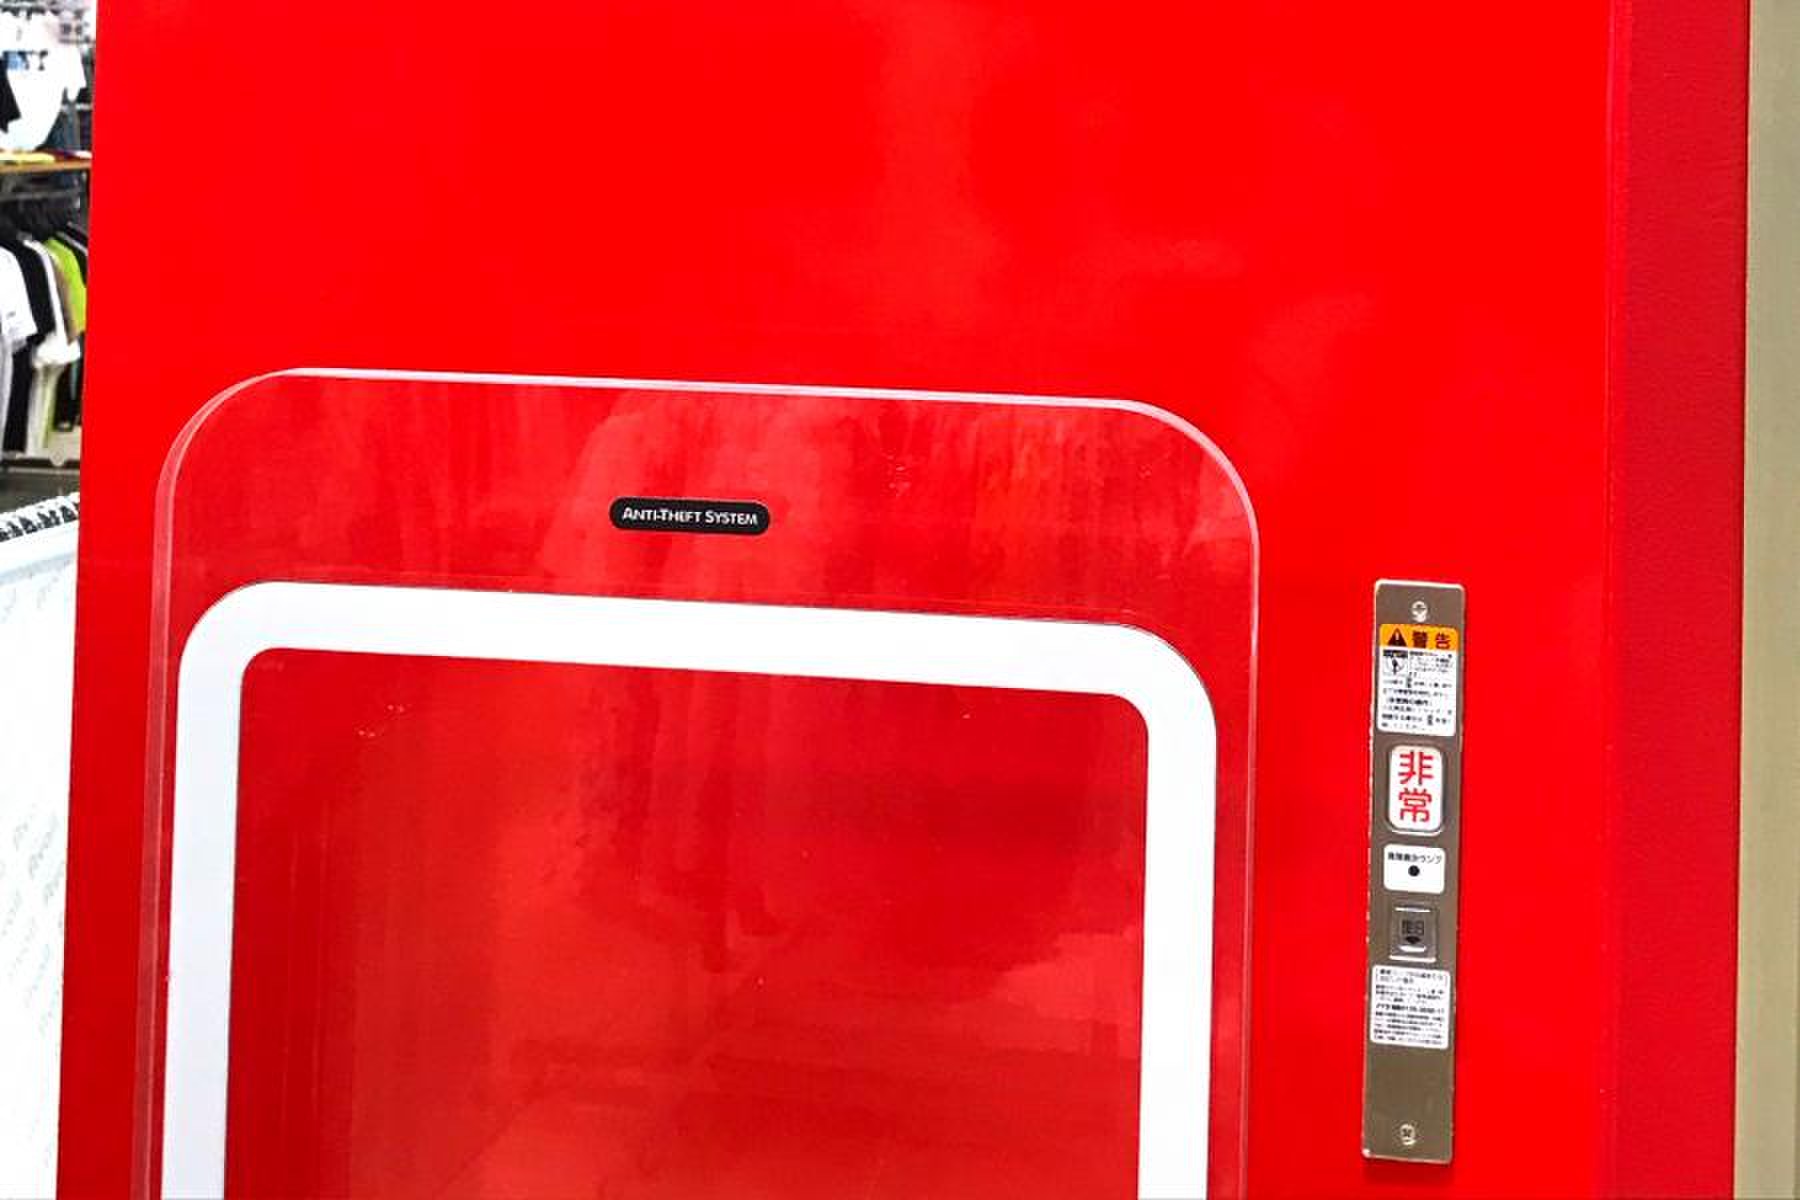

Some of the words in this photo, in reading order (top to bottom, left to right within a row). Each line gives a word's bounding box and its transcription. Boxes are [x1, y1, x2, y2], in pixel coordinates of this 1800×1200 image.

[622, 507, 702, 523] ANTI-THEFT
[705, 510, 758, 526] SYSTEM
[1412, 631, 1451, 649] 警告
[1397, 751, 1434, 823] 非常
